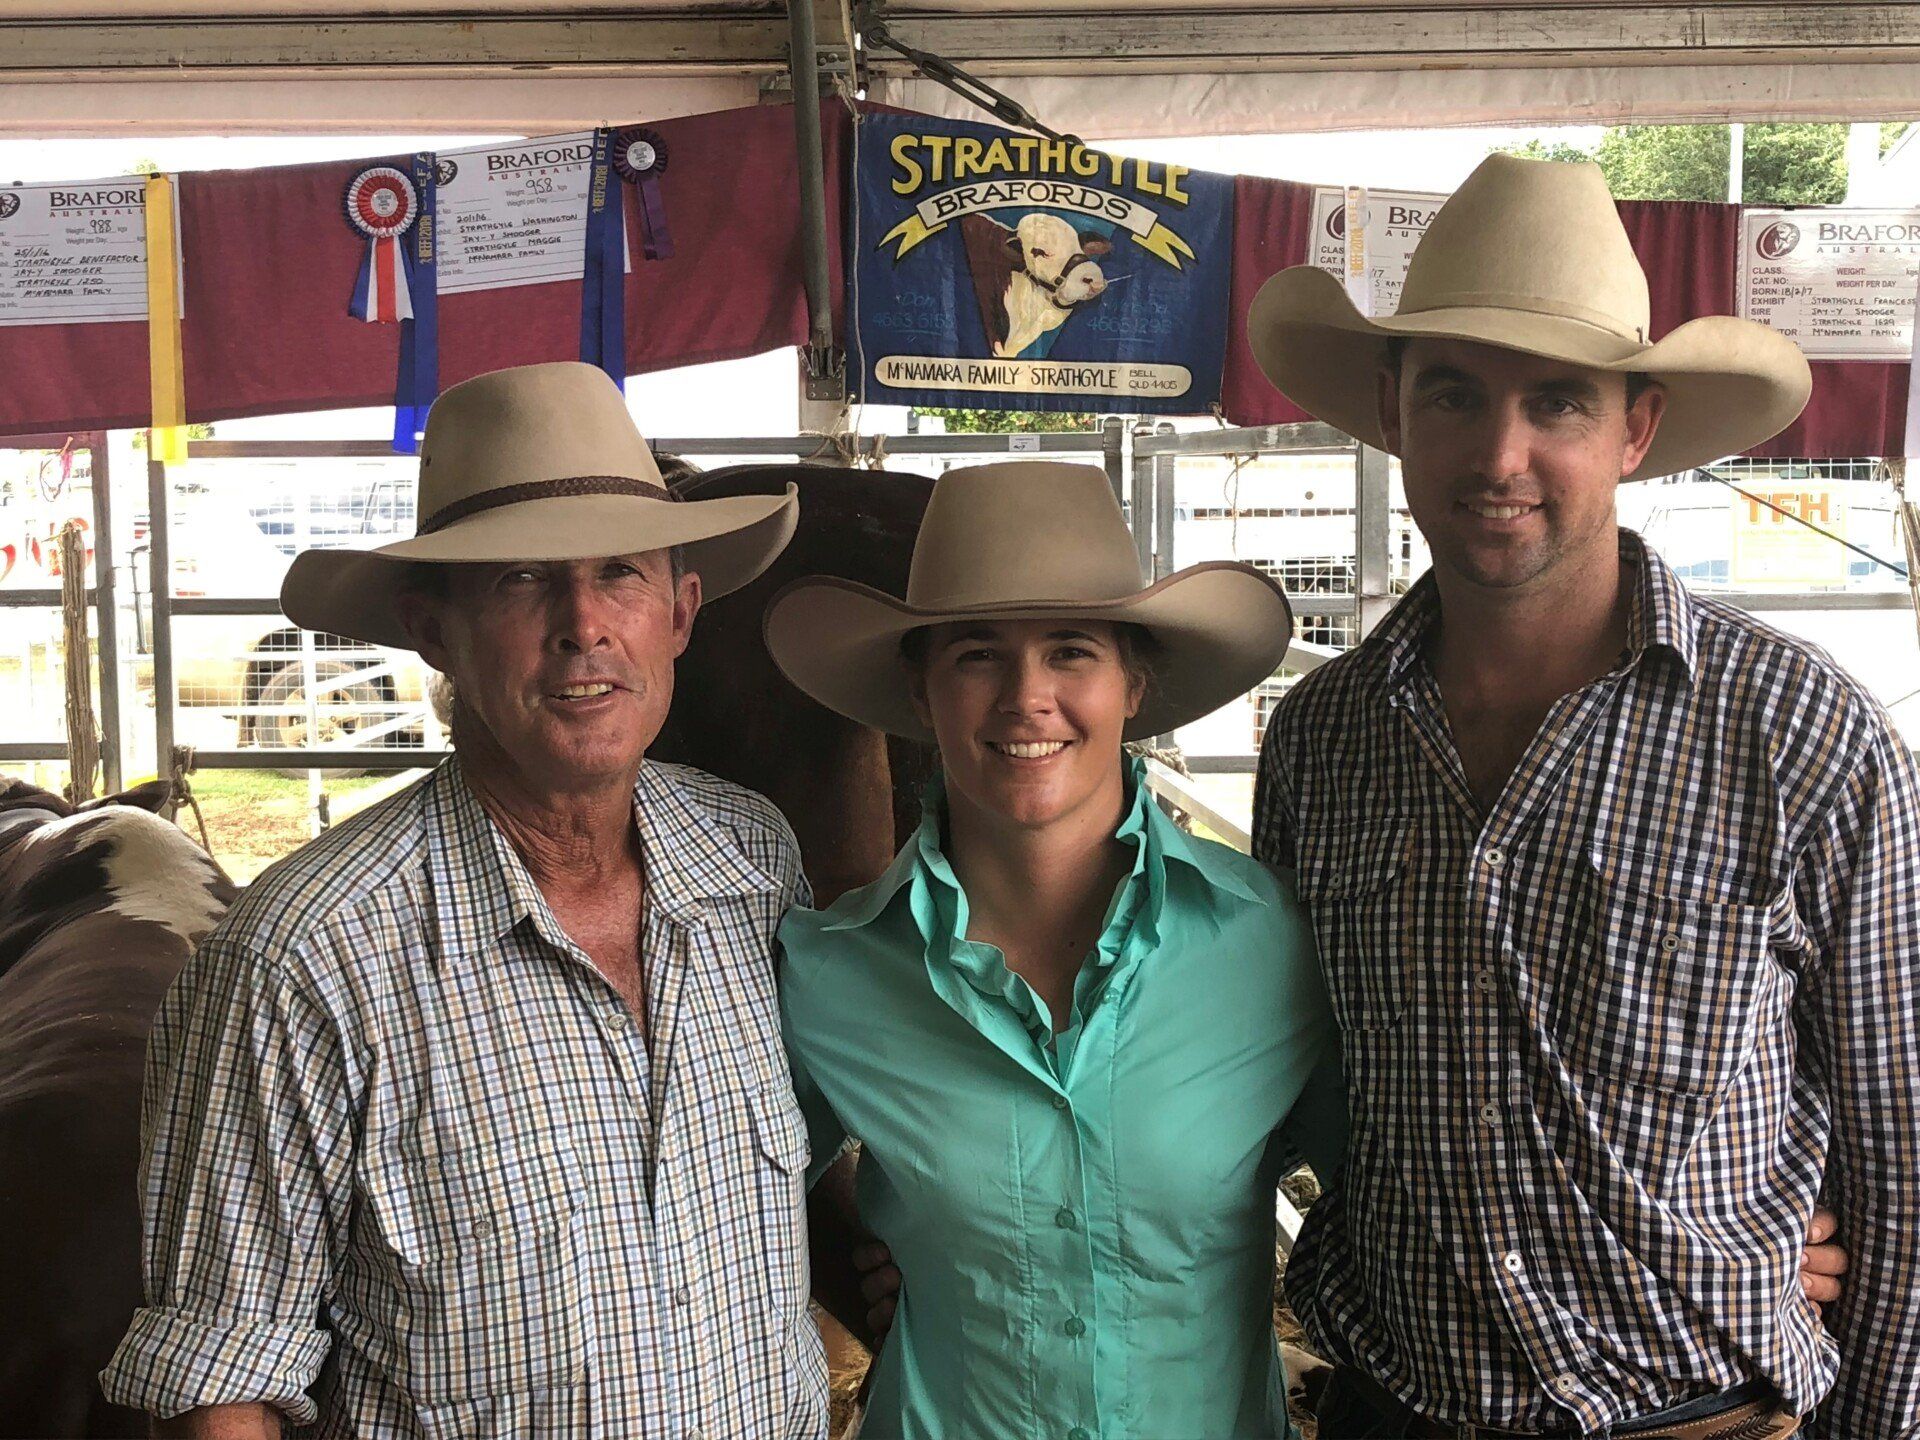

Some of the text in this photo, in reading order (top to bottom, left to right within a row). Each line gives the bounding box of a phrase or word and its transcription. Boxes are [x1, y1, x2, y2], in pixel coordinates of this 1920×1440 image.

[486, 143, 594, 172] BRAFORD
[487, 164, 583, 182] AUSTRALI
[889, 133, 1190, 206] STRATHGYLE
[525, 177, 553, 195] 958
[931, 181, 1132, 220] BRAFORDS
[49, 208, 145, 218] AUSTRALI
[1387, 206, 1436, 227] BRA
[1384, 229, 1425, 239] AUS
[1818, 222, 1920, 241] BRAFOR
[1320, 245, 1345, 255] CLAS
[1816, 246, 1917, 254] AUSTRAL
[1836, 280, 1864, 288] WEIGHT
[1865, 280, 1880, 288] PER
[1881, 280, 1896, 288] DAY
[1751, 297, 1786, 305] EXHIBIT
[1750, 307, 1771, 316] SIRE
[967, 364, 1021, 386] FAMILY
[1129, 369, 1157, 378] BELL
[1128, 380, 1149, 390] QLD
[1741, 492, 1829, 524] TFH
